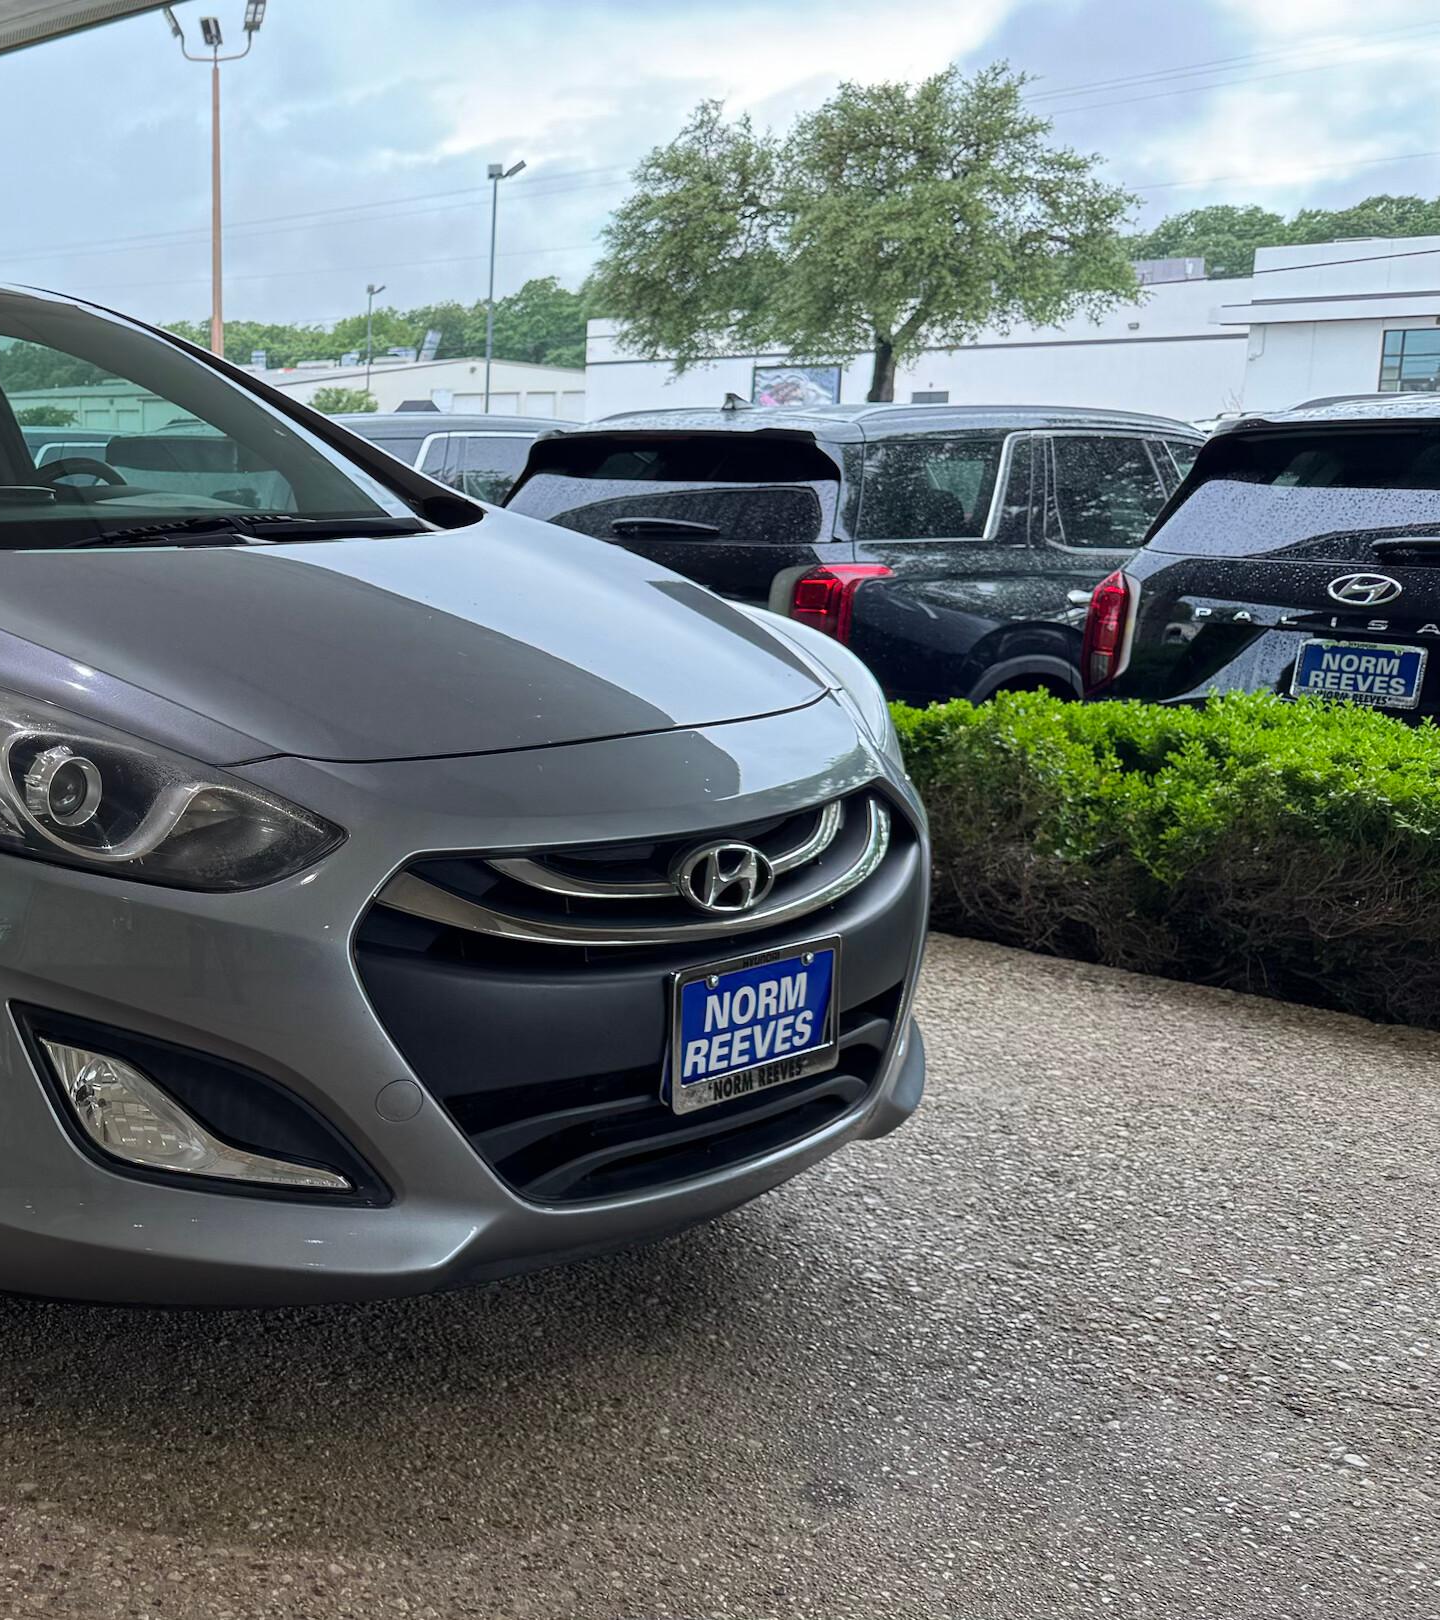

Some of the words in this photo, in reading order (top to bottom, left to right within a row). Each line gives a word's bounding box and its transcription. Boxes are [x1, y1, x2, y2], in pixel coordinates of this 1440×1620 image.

[1195, 607, 1440, 635] PALISA
[1321, 653, 1400, 676] NORM
[1308, 670, 1406, 696] REEVES
[704, 972, 807, 1032] NORM
[683, 1010, 813, 1077] REEVES
